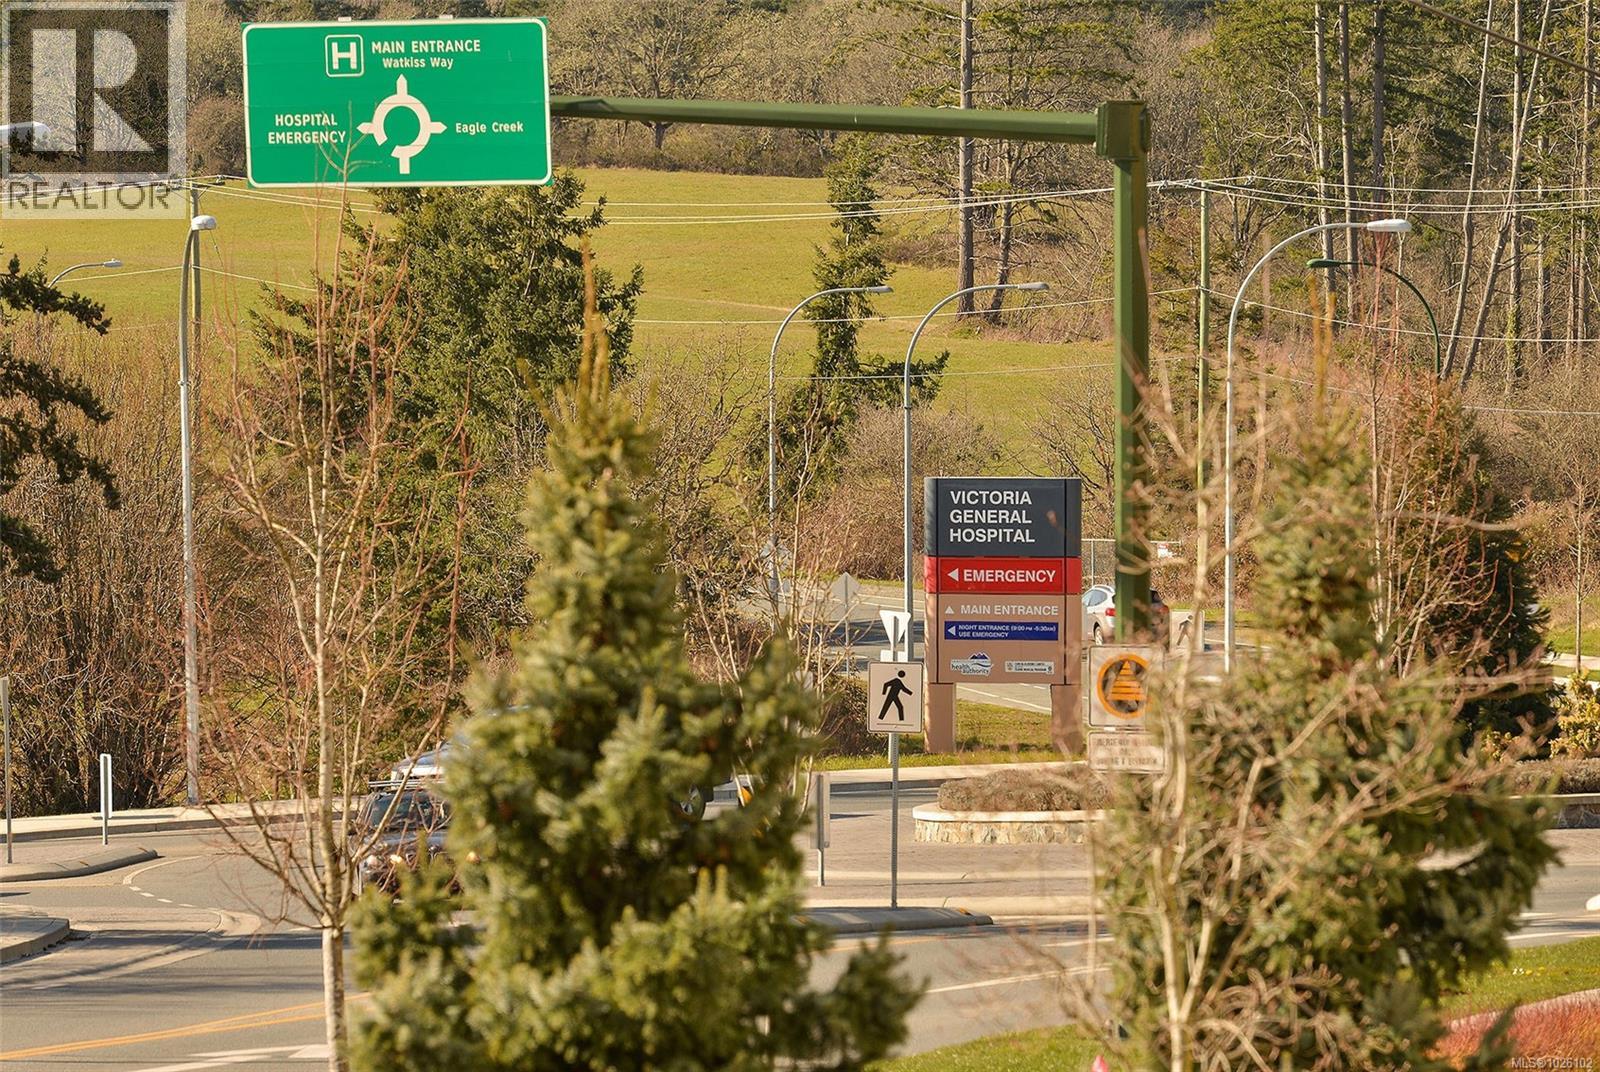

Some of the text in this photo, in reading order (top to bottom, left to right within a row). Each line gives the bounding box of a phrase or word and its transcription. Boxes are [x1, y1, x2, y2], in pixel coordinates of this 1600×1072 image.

[371, 39, 481, 54] MAIN ENTRANCE
[331, 42, 357, 69] H
[382, 56, 454, 70] Watkiss Way
[275, 113, 338, 127] HOSPITAL
[455, 121, 524, 135] Eagle Creek
[267, 130, 346, 144] EMERGENCY
[950, 490, 1032, 505] VICTORIA
[949, 509, 1032, 524] GENERAL
[949, 528, 1035, 543] HOSPITAL
[963, 569, 1056, 583] EMERGENCY
[960, 604, 1059, 616] MAIN ENTRANCE
[951, 663, 971, 671] health
[962, 667, 989, 675] authority
